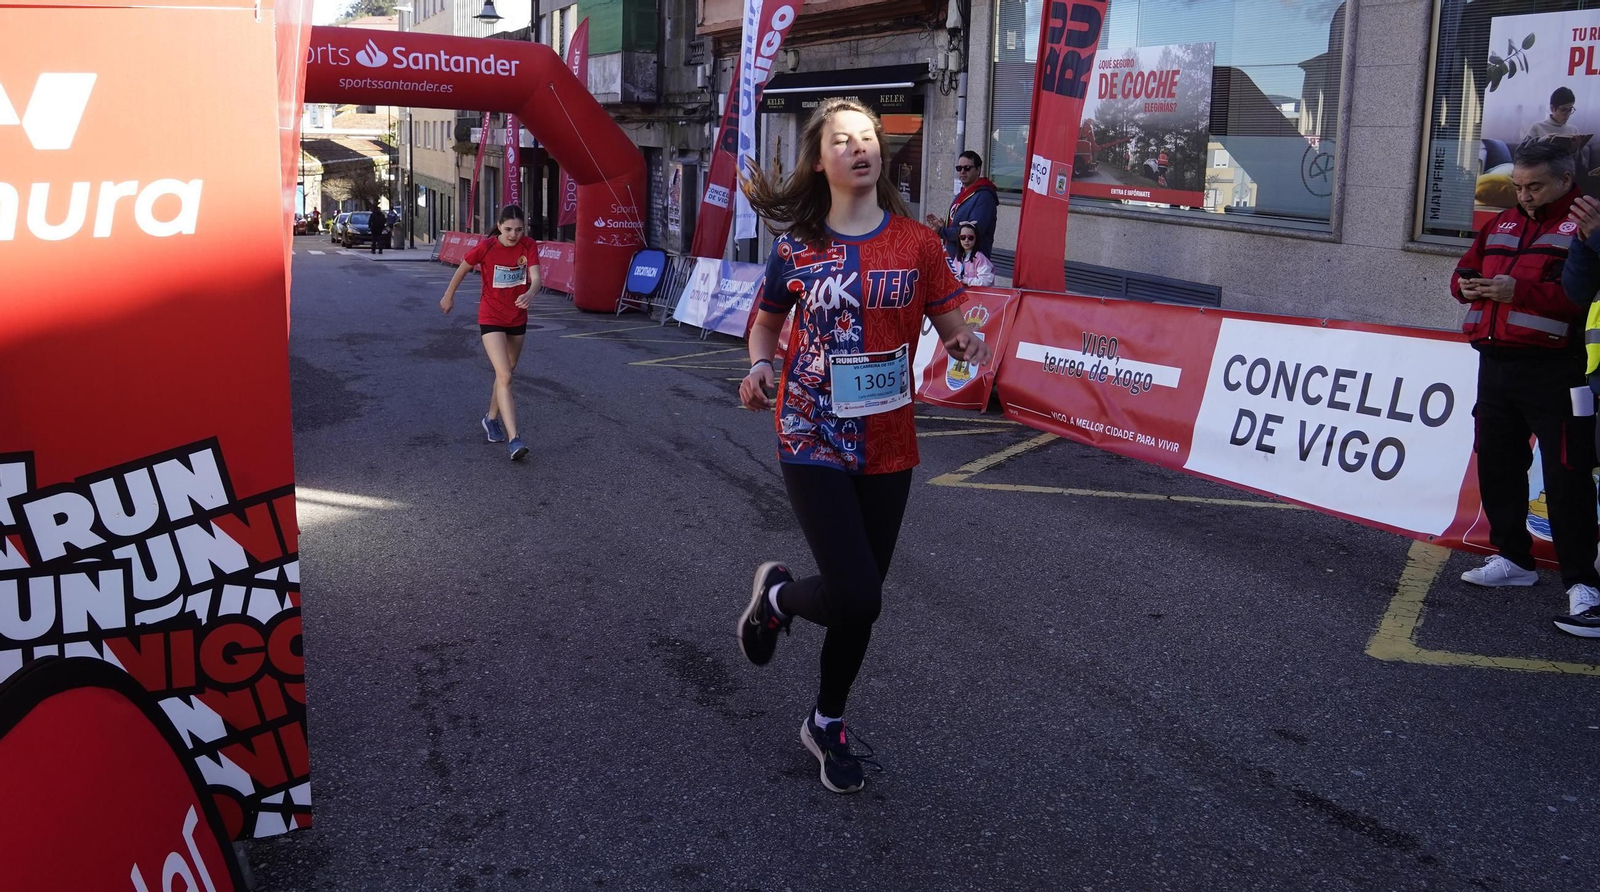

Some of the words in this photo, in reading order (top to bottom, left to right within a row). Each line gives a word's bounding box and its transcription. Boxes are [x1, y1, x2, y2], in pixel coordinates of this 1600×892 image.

[1572, 27, 1587, 41] TU
[393, 46, 520, 77] Santander
[1113, 58, 1135, 69] SEGURO
[1568, 45, 1600, 76] PL
[339, 77, 454, 93] sportssantander.es
[879, 94, 905, 103] KELER
[1098, 72, 1119, 100] DE
[1121, 69, 1181, 100] COCHE
[1144, 99, 1178, 113] ELEGIRÍAS?
[0, 178, 204, 241] ura
[866, 268, 920, 310] TEIS
[1081, 331, 1120, 366] VIGO,
[854, 370, 896, 391] 1305
[1043, 351, 1085, 378] terreo
[1088, 360, 1109, 383] de
[1112, 367, 1154, 395] xogo
[1223, 354, 1455, 428] CONCELLO
[1069, 417, 1075, 425] A
[1076, 418, 1104, 433] MELLOR
[1105, 425, 1134, 441] CIDADE
[1136, 432, 1156, 447] PARA
[1158, 438, 1180, 453] VIVIR
[1229, 408, 1284, 455] DE
[1299, 419, 1406, 481] VIGO
[22, 447, 229, 562] RUN
